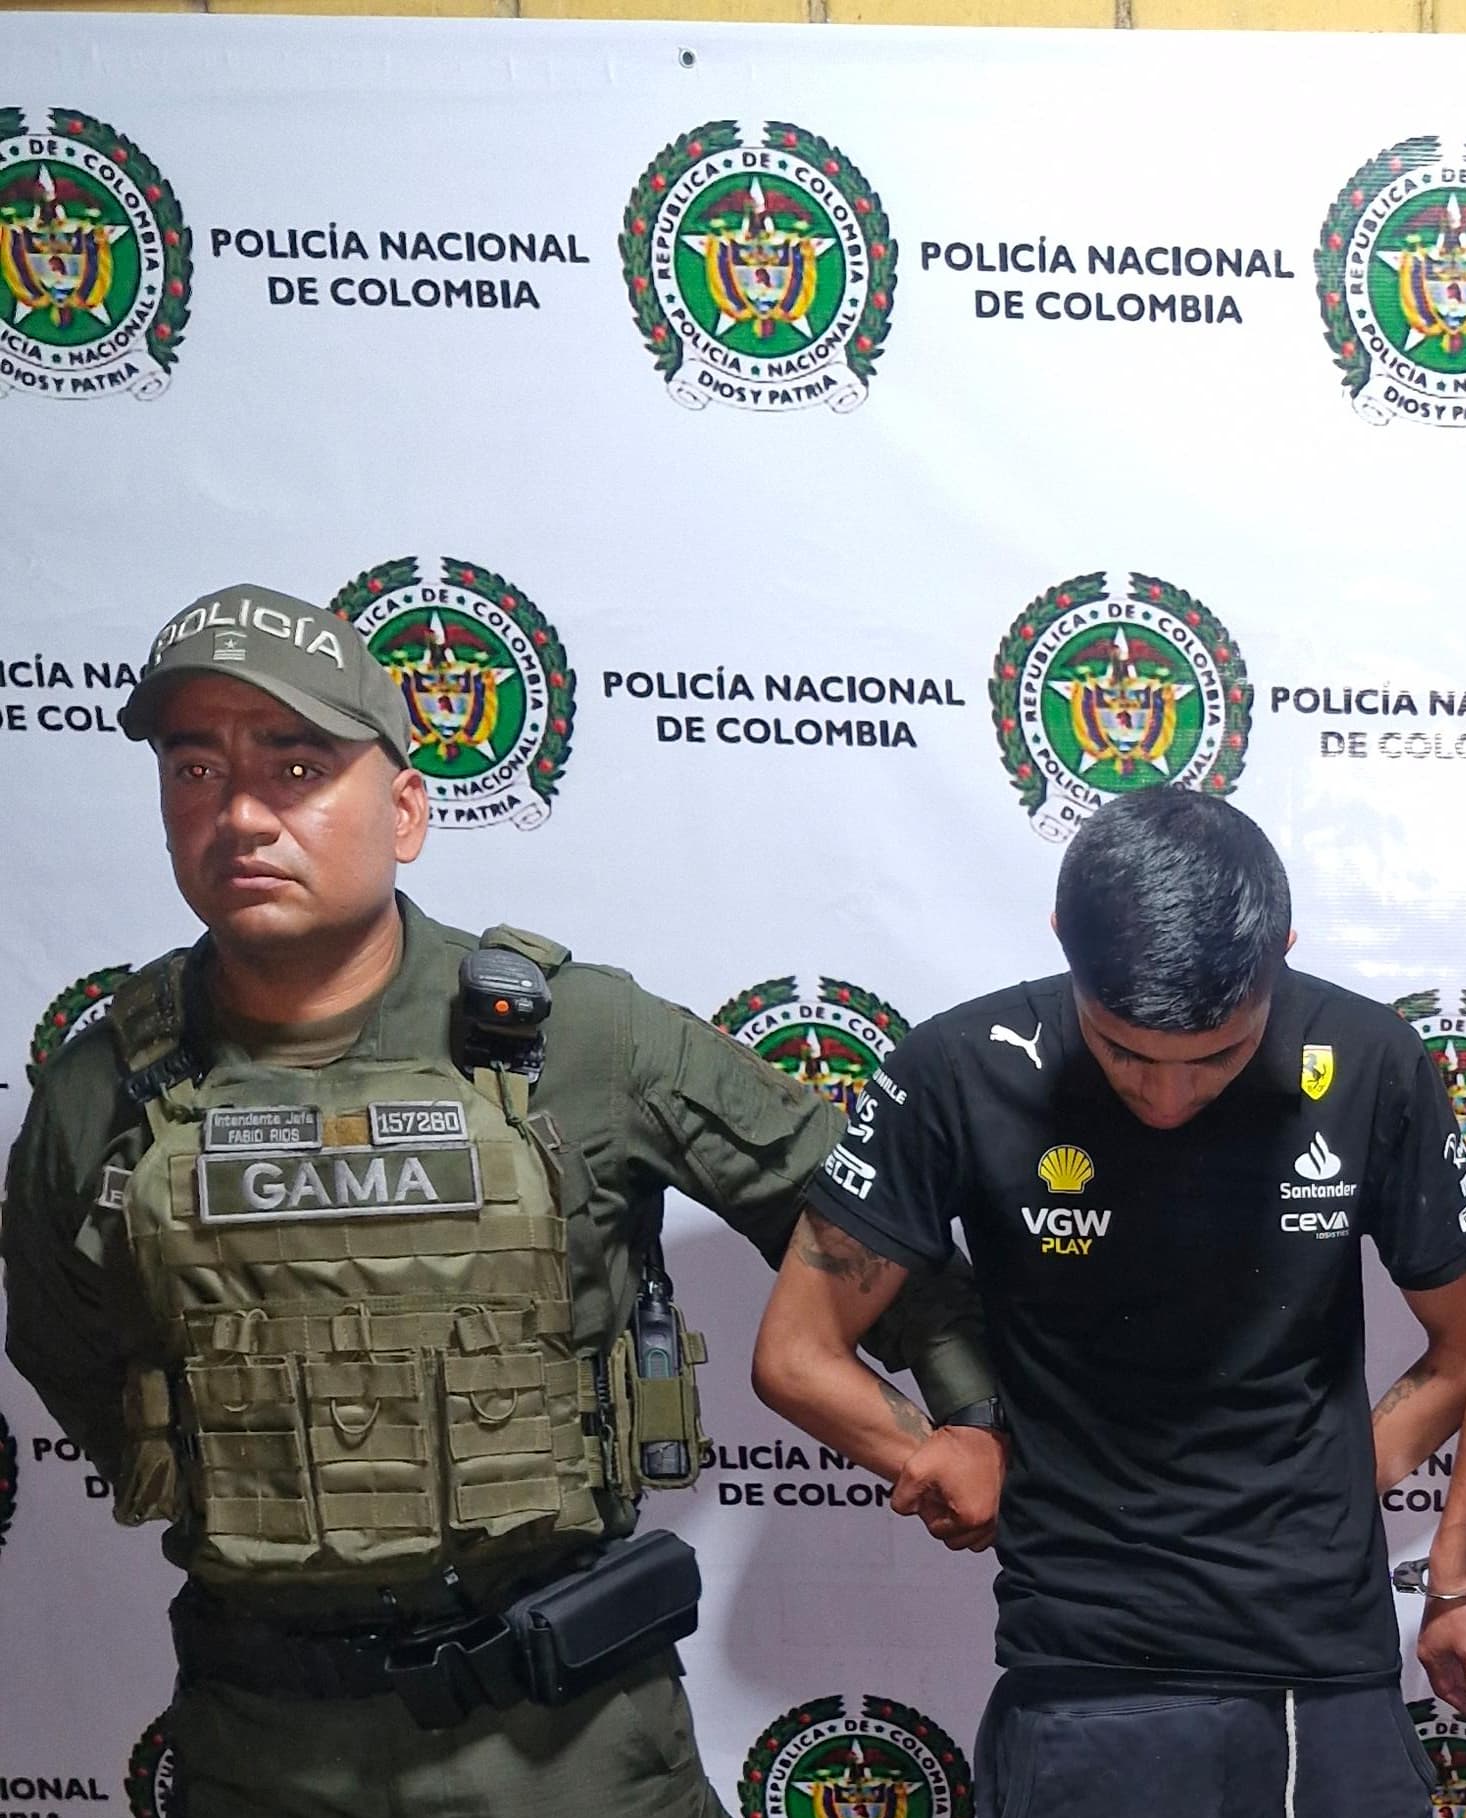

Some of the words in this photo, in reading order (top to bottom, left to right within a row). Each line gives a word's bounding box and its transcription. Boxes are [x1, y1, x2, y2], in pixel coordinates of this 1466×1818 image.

[29, 139, 59, 156] DE
[83, 154, 160, 271] COLOMBIA
[743, 152, 771, 168] DE
[795, 167, 864, 283] COLOMBIA
[211, 222, 368, 259] POLICÍA
[380, 231, 589, 263] NACIONAL
[921, 236, 1076, 273] POLICÍA
[1088, 246, 1294, 278] NACIONAL
[268, 277, 319, 305] DE
[330, 277, 540, 309] COLOMBIA
[975, 290, 1024, 319] DE
[1036, 292, 1242, 324] COLOMBIA
[0, 330, 42, 362] ICIA
[68, 300, 155, 366] NACIONAL
[671, 308, 741, 373] POLICIA
[768, 313, 856, 377] NACIONAL
[1360, 323, 1428, 389] POLICIA
[0, 358, 50, 391] DIOS
[51, 377, 65, 393] Y
[70, 362, 141, 393] PATRIA
[698, 370, 747, 402] DIOS
[750, 389, 762, 404] Y
[768, 375, 838, 404] PATRIA
[1383, 385, 1432, 418] DIOS
[1433, 404, 1447, 420] Y
[422, 588, 450, 604] DE
[473, 602, 544, 710] COLOMBIA
[1108, 603, 1136, 619] DE
[1157, 617, 1222, 725] COLOMBIA
[0, 653, 74, 688] ICÍA
[604, 666, 754, 701] POLICÍA
[765, 675, 965, 706] NACIONAL
[1271, 680, 1419, 716] POLICÍA
[657, 716, 705, 743] DE
[717, 718, 917, 747] COLOMBIA
[1320, 731, 1368, 758] DE
[453, 737, 538, 797] NACIONAL
[436, 807, 449, 822] Y
[454, 794, 523, 822] PATRIA
[800, 1005, 827, 1020] DE
[1440, 1018, 1466, 1033] DE
[214, 1112, 281, 1127] Intendente
[286, 1111, 313, 1124] Jefe
[228, 1130, 263, 1143] FABIO
[270, 1129, 300, 1142] RIOS
[377, 1110, 460, 1136] 157260
[243, 1157, 439, 1209] GAMA
[1280, 1181, 1357, 1199] Santander
[1021, 1208, 1112, 1237] VGW
[1042, 1237, 1093, 1256] PLAY
[719, 1483, 764, 1506] DE
[1436, 1723, 1460, 1735] DE
[845, 1720, 870, 1732] DE
[889, 1730, 949, 1814] COLOMBIA
[0, 1777, 109, 1800] IONAL
